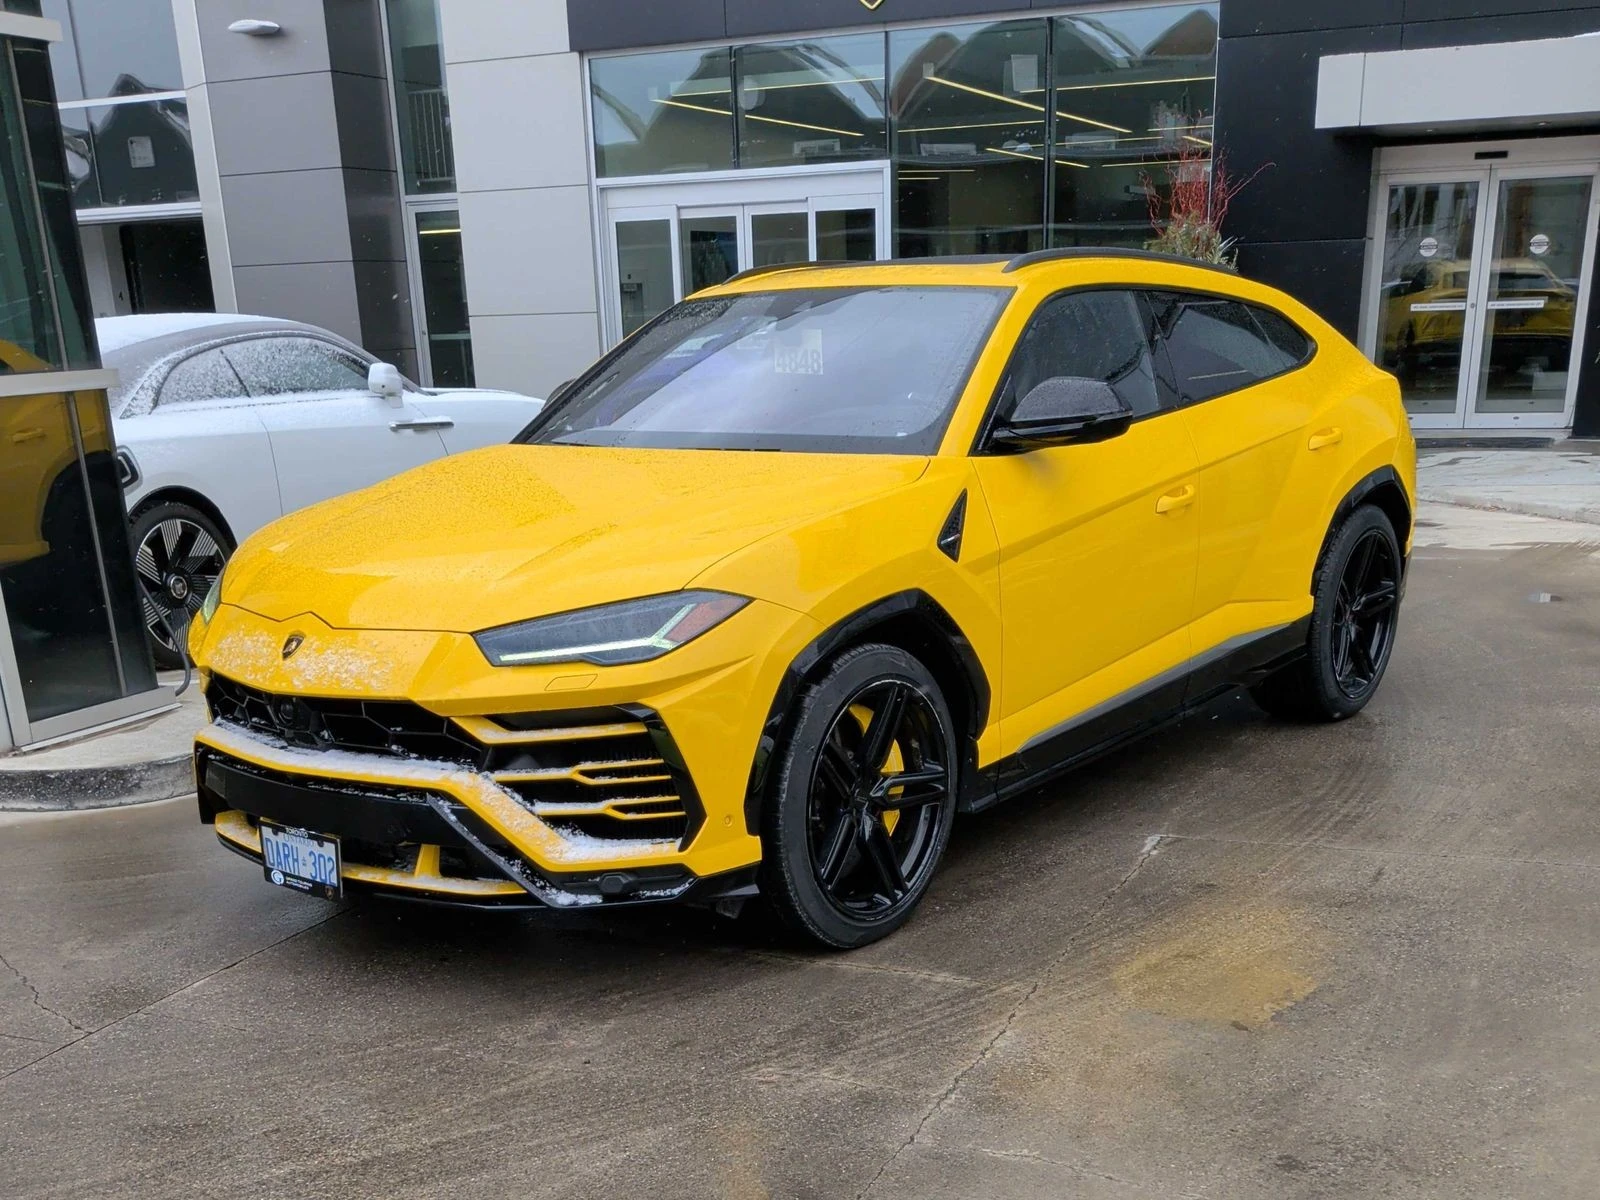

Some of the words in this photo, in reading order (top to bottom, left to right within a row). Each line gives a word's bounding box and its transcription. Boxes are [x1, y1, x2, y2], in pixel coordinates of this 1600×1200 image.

[776, 349, 821, 374] 4848
[265, 837, 300, 874] DARH
[308, 850, 337, 887] 302
